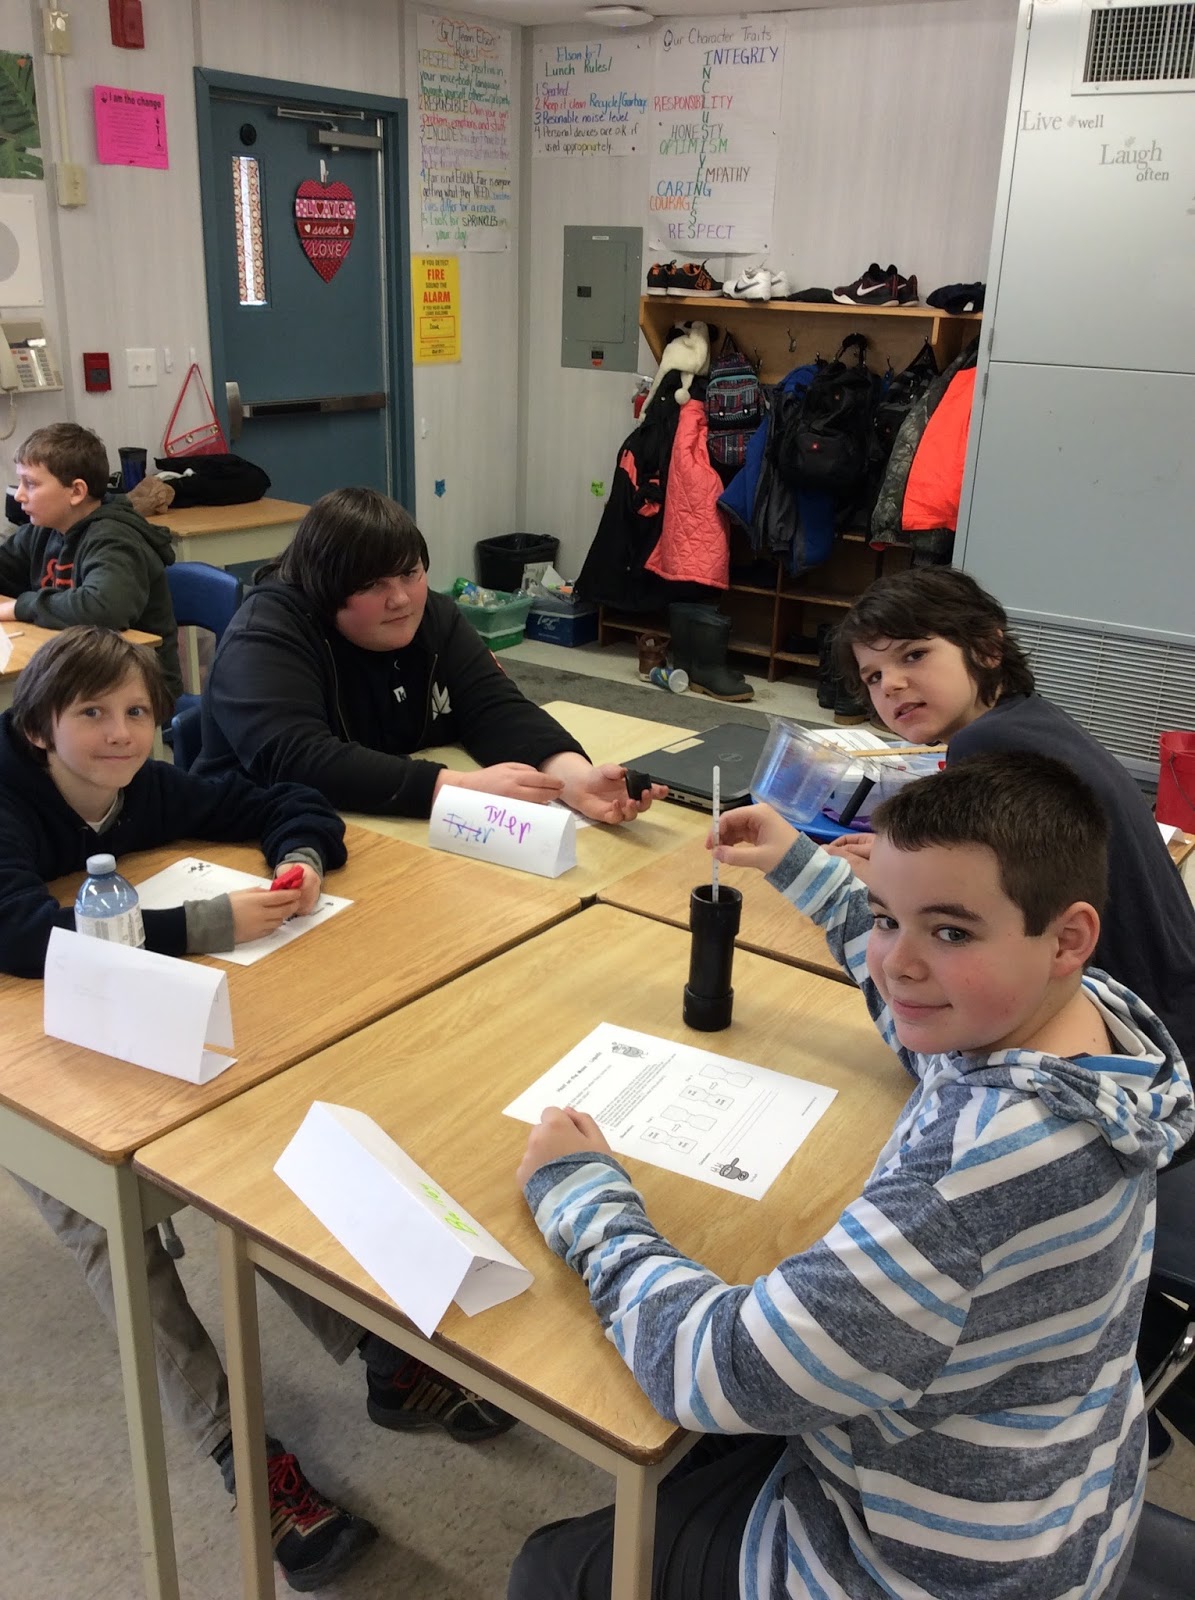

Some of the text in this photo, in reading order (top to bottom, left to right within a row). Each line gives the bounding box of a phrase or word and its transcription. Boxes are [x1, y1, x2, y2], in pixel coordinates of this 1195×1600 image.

[664, 25, 772, 47] Our Character Traits
[556, 46, 582, 62] Elson
[545, 62, 575, 77] Lunch
[542, 81, 569, 97] Seated
[113, 94, 123, 103] am
[124, 94, 135, 105] the
[137, 97, 162, 110] change
[543, 98, 559, 114] Keep
[560, 98, 566, 110] it
[569, 98, 587, 110] clean
[534, 112, 542, 125] 3
[582, 114, 604, 123] noise
[608, 111, 628, 123] level
[1021, 110, 1104, 131] Live well
[534, 126, 541, 139] 4
[543, 124, 573, 138] Personal
[600, 127, 612, 136] are
[671, 123, 724, 140] HONESTY
[545, 140, 560, 152] used
[660, 138, 728, 155] OPTIMISM
[1100, 140, 1162, 171] Laugh
[697, 167, 751, 183] EMPATHY
[1136, 168, 1169, 182] often
[657, 180, 711, 197] CARING
[650, 195, 699, 211] COURAGE
[430, 213, 447, 227] Look
[312, 224, 341, 236] sweet
[668, 223, 736, 239] RESPECT
[312, 243, 342, 257] LOVE
[427, 269, 445, 281] FIRE
[423, 291, 451, 303] ALARM
[484, 805, 531, 844] Tyler
